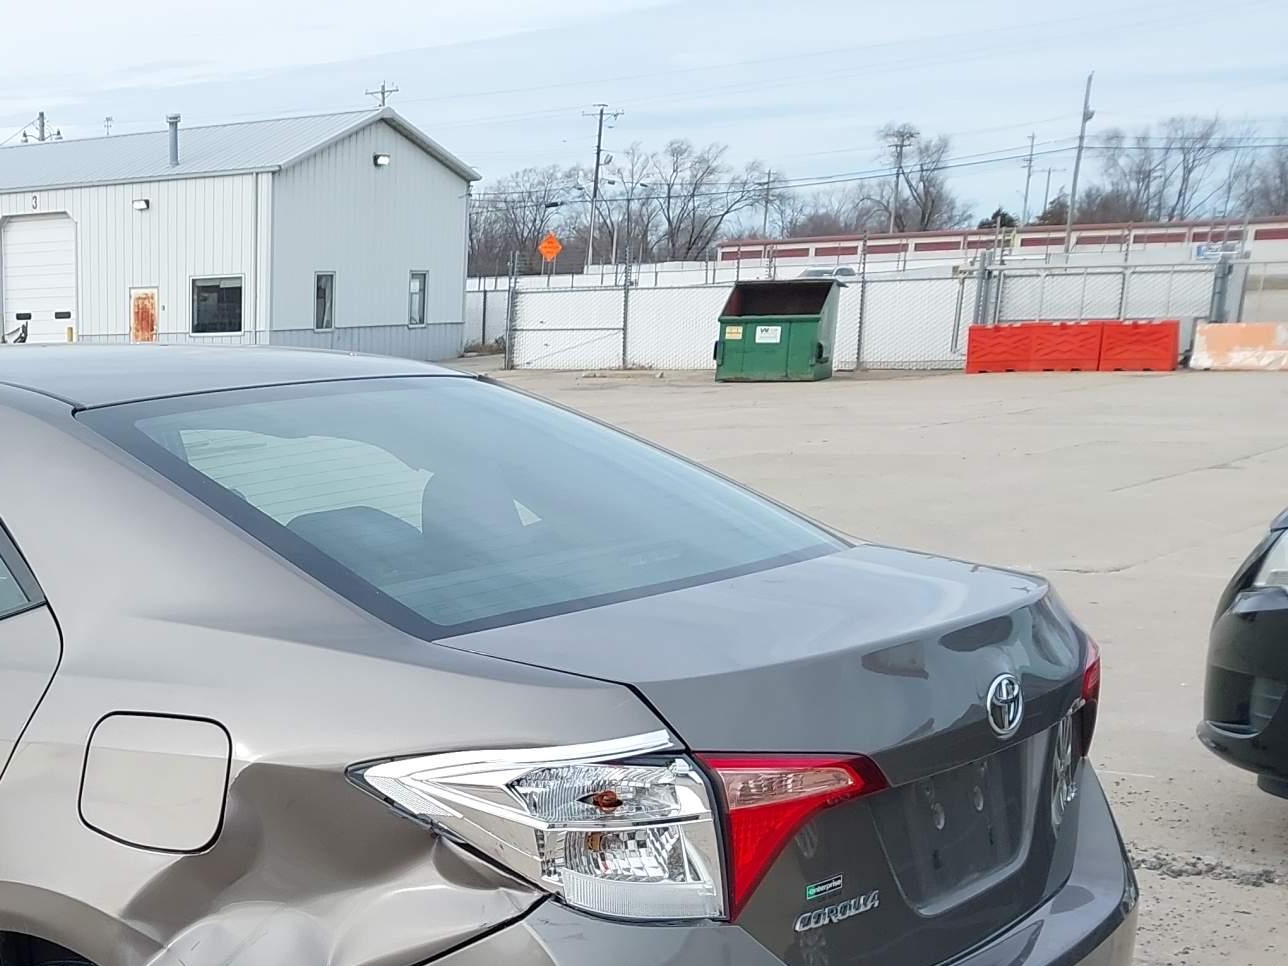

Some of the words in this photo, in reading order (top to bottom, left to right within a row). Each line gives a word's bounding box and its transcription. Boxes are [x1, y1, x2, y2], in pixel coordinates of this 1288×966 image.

[32, 195, 38, 210] 3
[808, 879, 842, 896] enterprise
[795, 889, 880, 932] COROLLA
